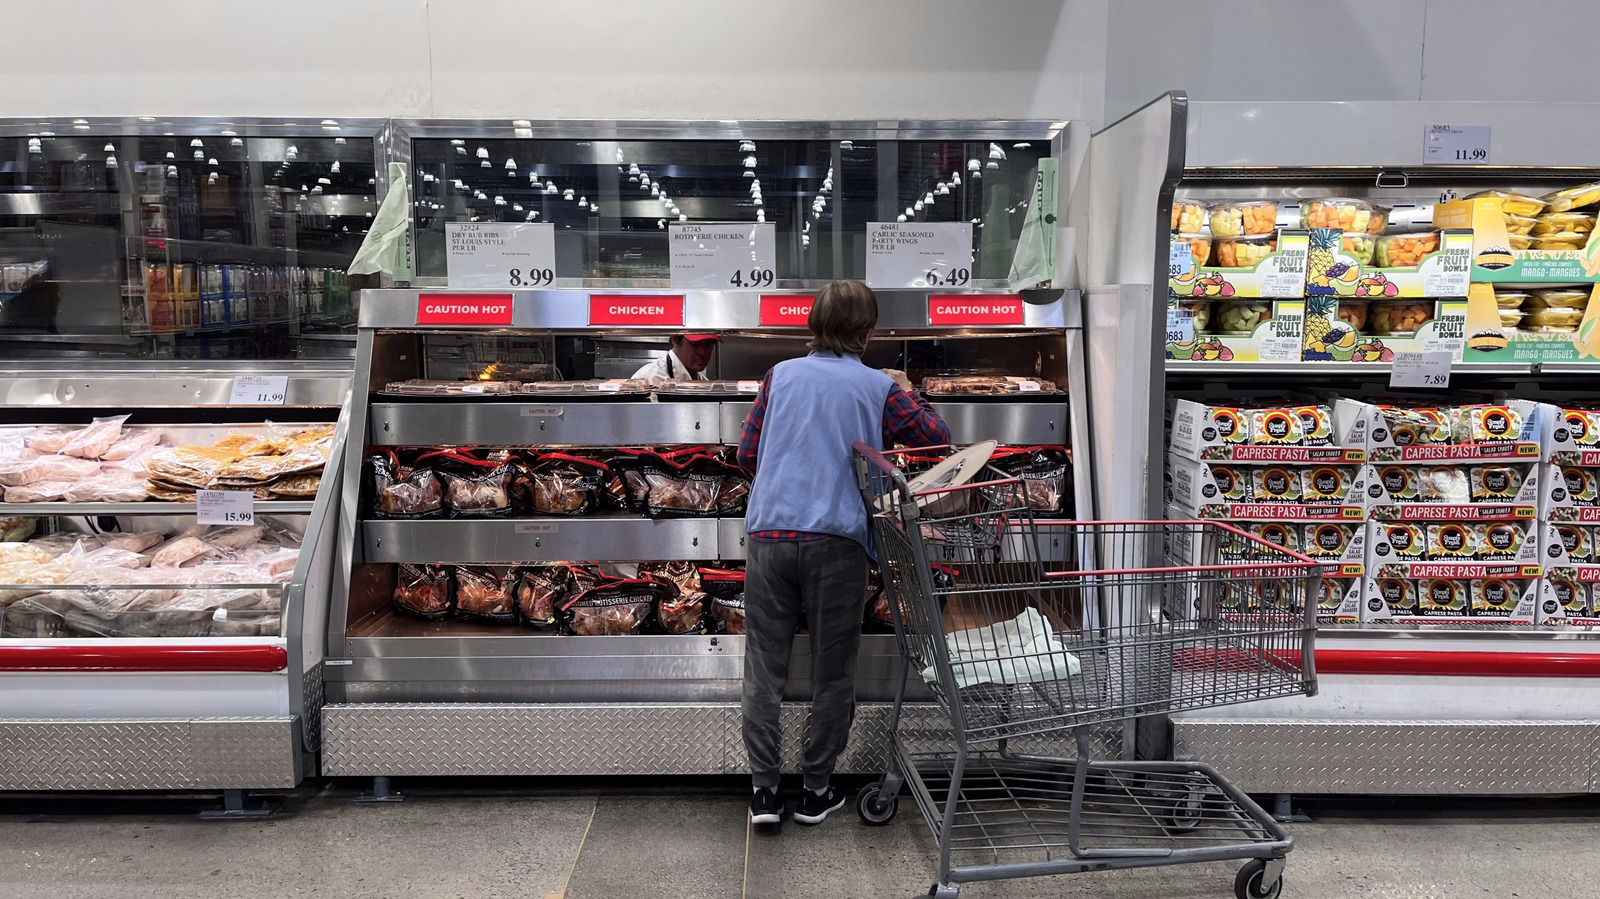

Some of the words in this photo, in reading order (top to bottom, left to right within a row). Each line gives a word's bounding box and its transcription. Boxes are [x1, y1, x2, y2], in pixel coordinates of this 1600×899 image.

[1456, 150, 1486, 160] 11.99
[1272, 257, 1304, 266] FRUIT
[1437, 256, 1469, 265] FRUIT
[509, 268, 554, 286] 8.99
[926, 268, 970, 286] 6.49
[1521, 268, 1545, 277] MANGO
[1549, 268, 1580, 277] MANGUES
[730, 269, 774, 287] 4.99
[425, 305, 479, 314] CAUTION
[482, 305, 507, 314] HOT
[609, 306, 664, 315] CHICKEN
[780, 306, 813, 315] CHIC
[936, 306, 989, 315] CAUTION
[992, 305, 1017, 314] HOT
[1270, 322, 1301, 331] FRUIT
[1432, 322, 1464, 332] FRUIT
[1514, 350, 1538, 359] MANGO
[1542, 350, 1573, 359] MANGUES
[1424, 375, 1446, 384] 7.89
[1236, 448, 1278, 459] CAPRESE
[1280, 449, 1310, 460] PASTA
[1406, 447, 1448, 459] CAPRESE
[1450, 446, 1481, 457] PASTA
[225, 512, 252, 521] 15.99
[1234, 506, 1275, 517] CAPRESE
[1278, 507, 1307, 518] PASTA
[1405, 507, 1447, 518] CAPRESE
[1449, 507, 1479, 518] PASTA
[1413, 566, 1456, 577] CAPRESE
[1457, 566, 1487, 577] PASTA
